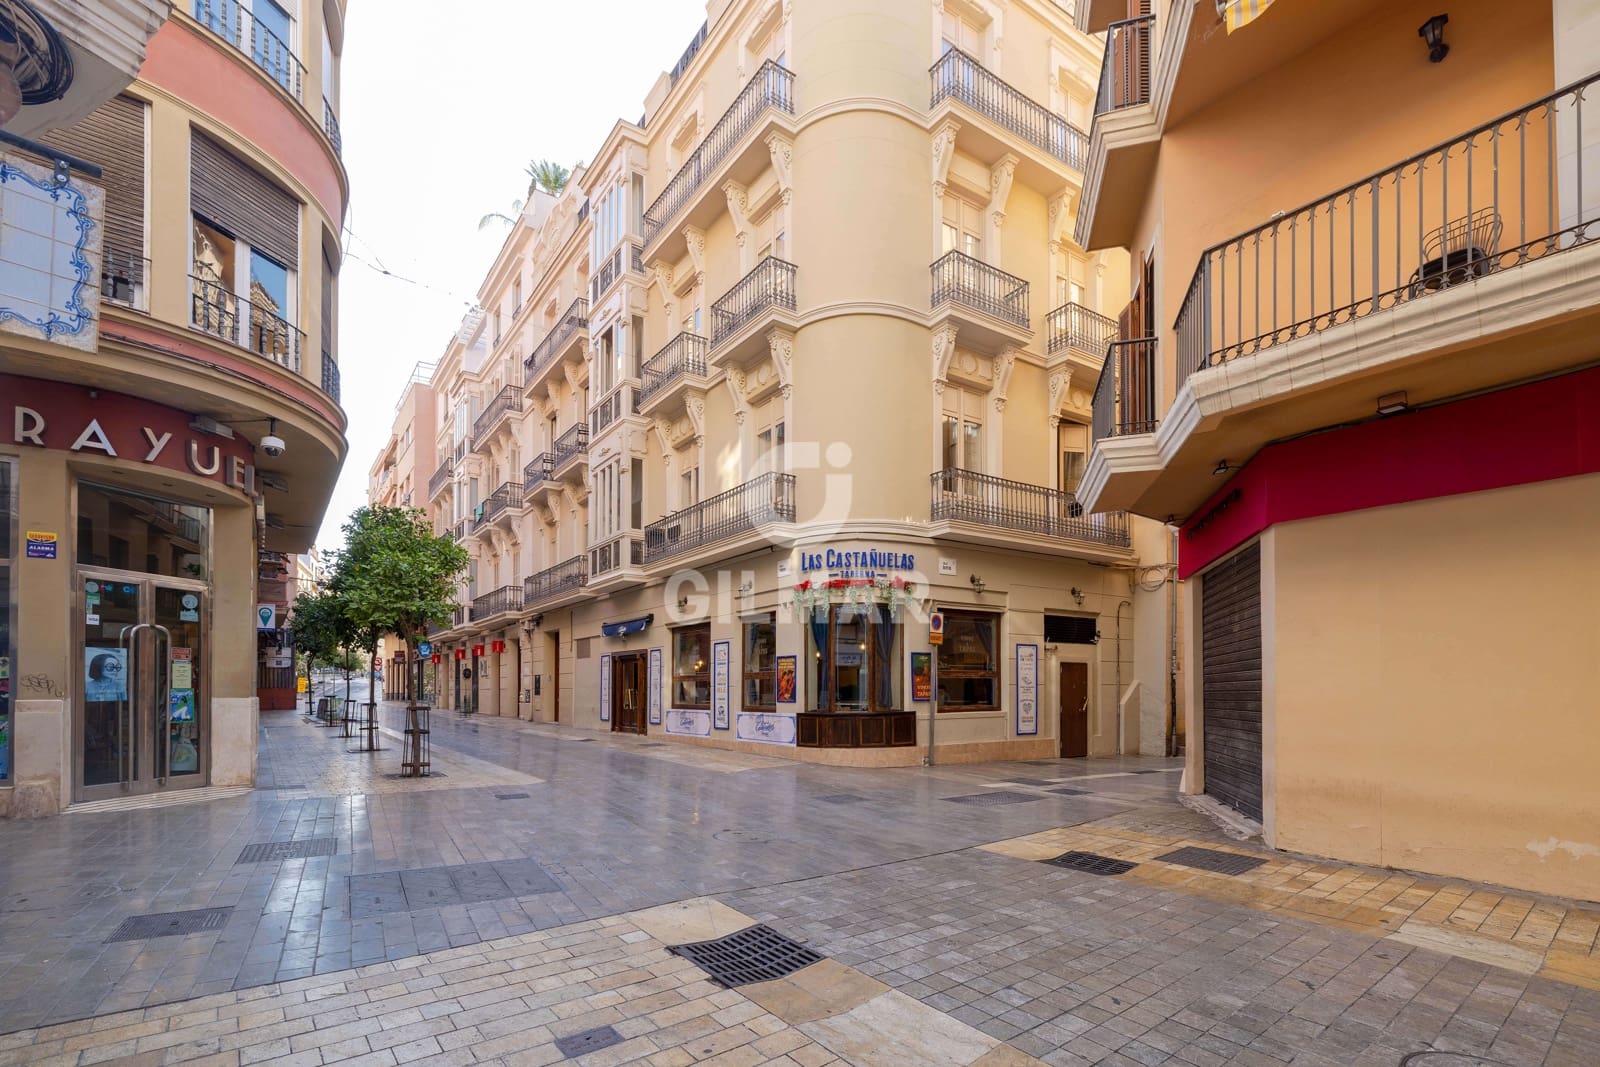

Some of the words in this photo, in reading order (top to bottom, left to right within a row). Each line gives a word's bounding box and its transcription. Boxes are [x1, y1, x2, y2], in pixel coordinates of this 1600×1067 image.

[801, 552, 823, 571] LAS
[826, 548, 915, 570] CASTAÑUELAS
[840, 570, 876, 579] TABERNA
